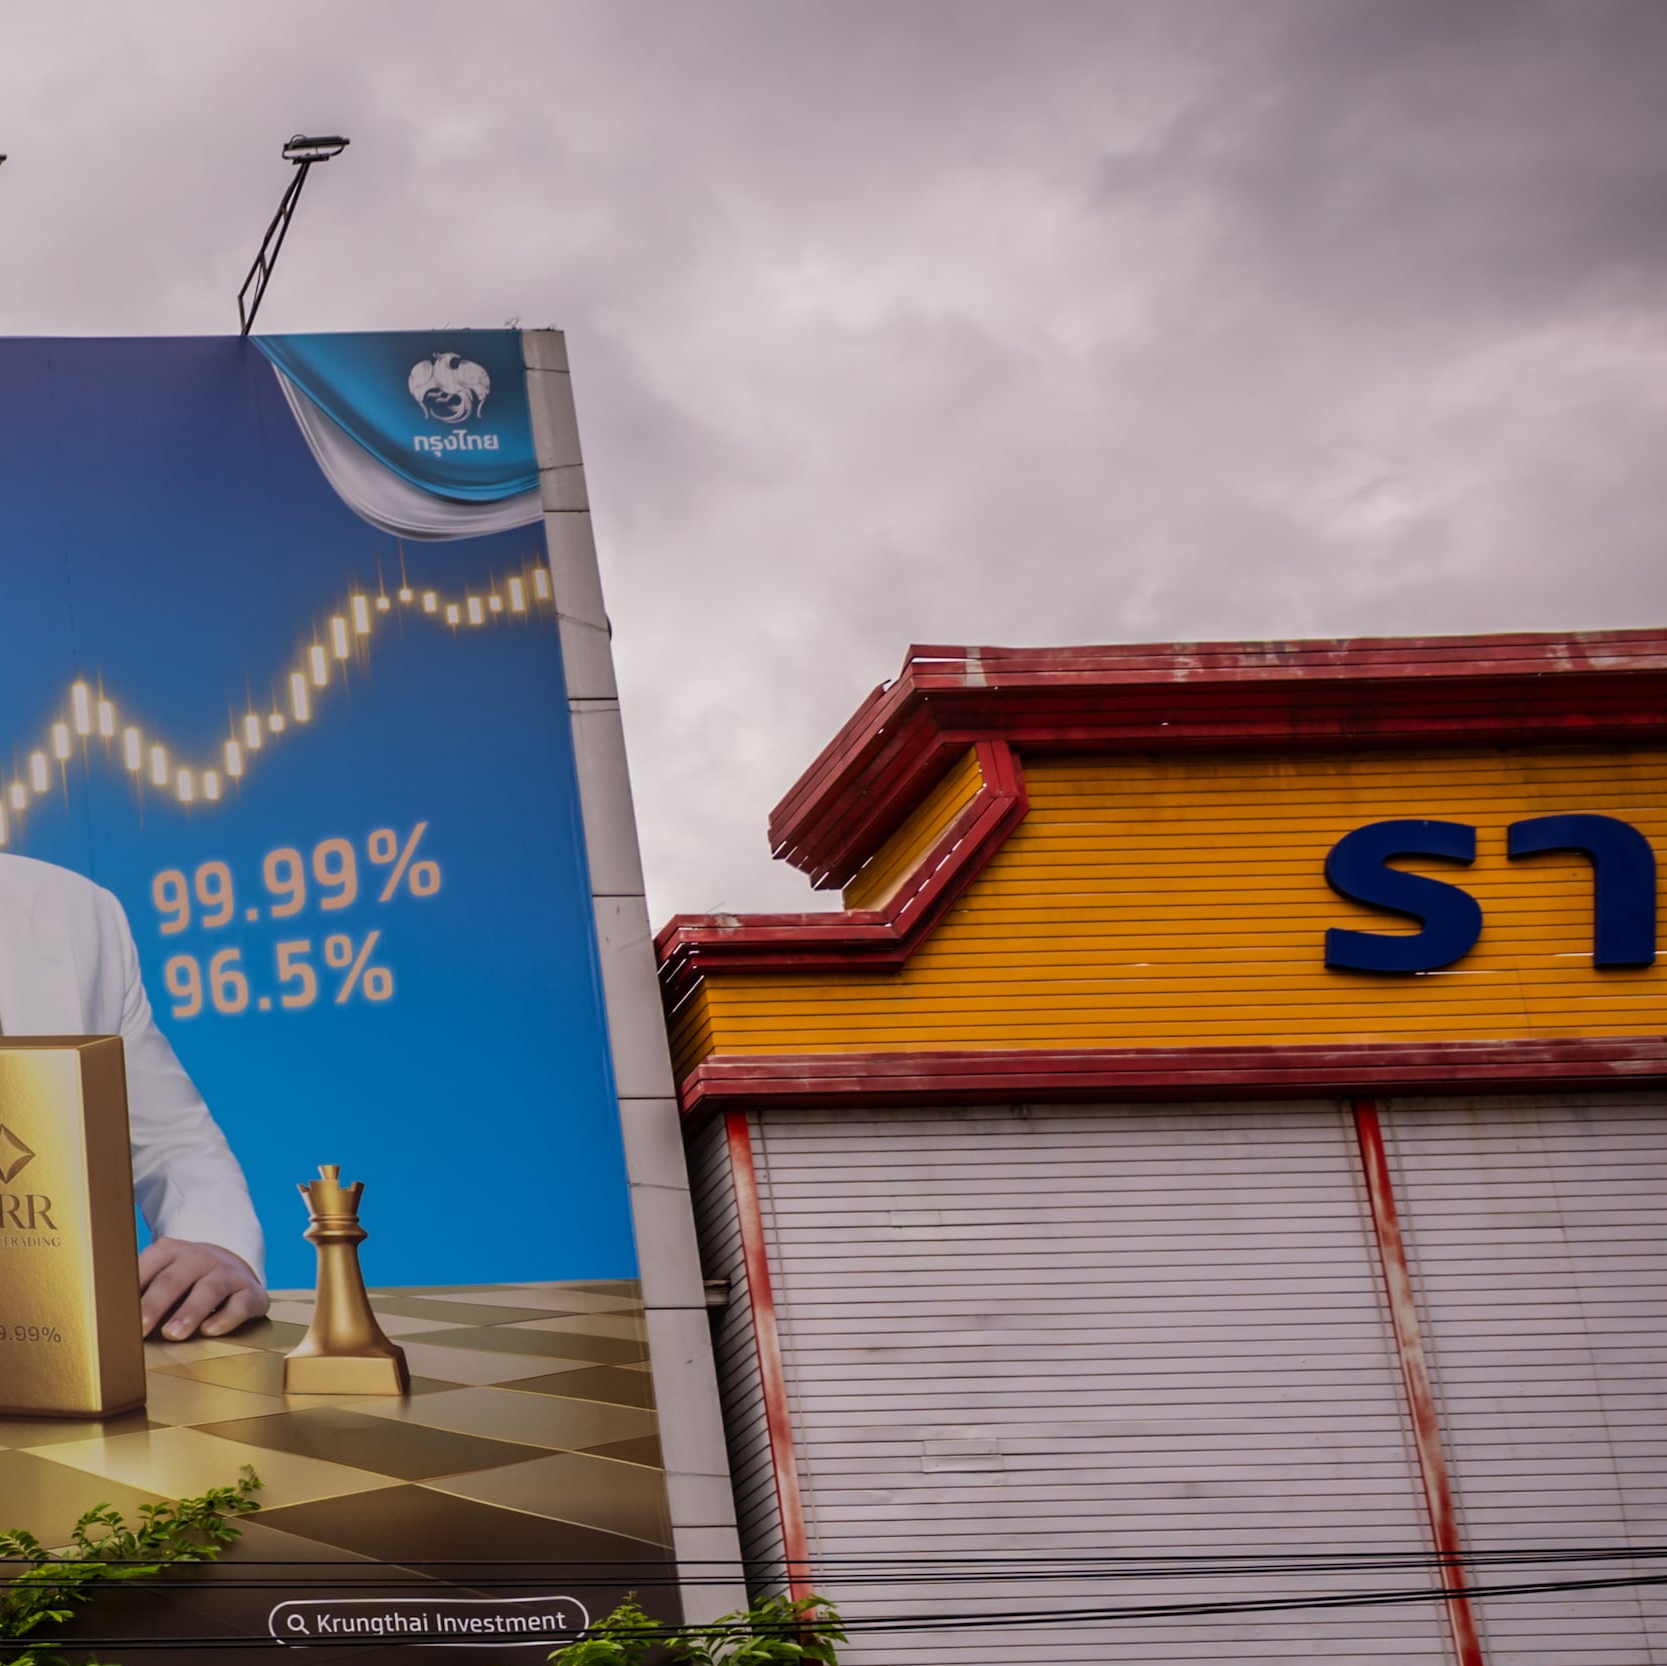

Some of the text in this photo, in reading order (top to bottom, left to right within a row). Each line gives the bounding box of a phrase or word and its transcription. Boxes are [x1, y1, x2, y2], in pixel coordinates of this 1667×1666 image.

[414, 429, 498, 457] กรุงไทย
[151, 821, 442, 935] 99.99%
[165, 931, 393, 1019] 96.5%
[3, 1236, 61, 1247] TRADING
[317, 1611, 566, 1637] Krungthai Investment
